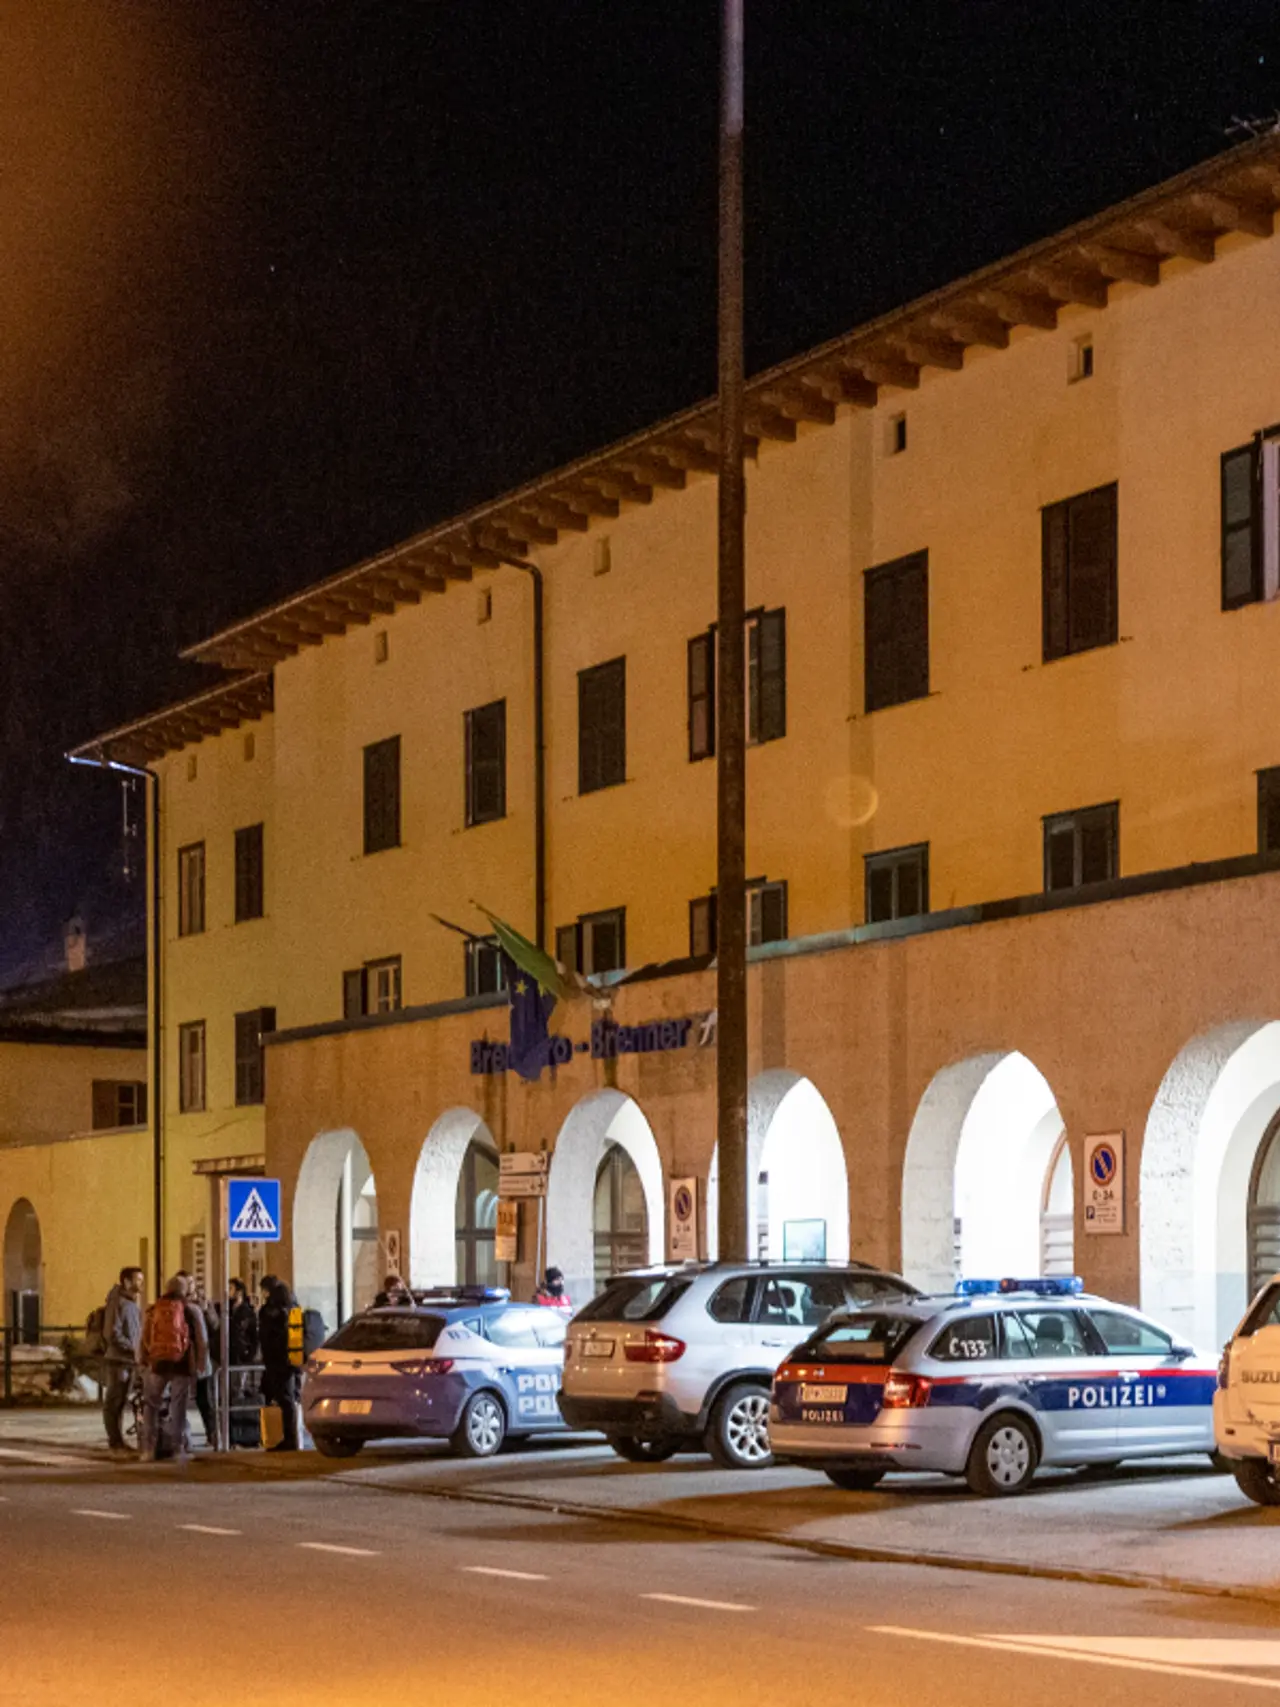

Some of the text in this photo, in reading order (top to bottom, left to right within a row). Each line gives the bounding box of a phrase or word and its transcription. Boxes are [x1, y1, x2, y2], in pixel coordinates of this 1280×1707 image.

[591, 1018, 692, 1058] Brenner
[1068, 1384, 1153, 1407] POLIZEI
[802, 1409, 844, 1422] POLIZEI
